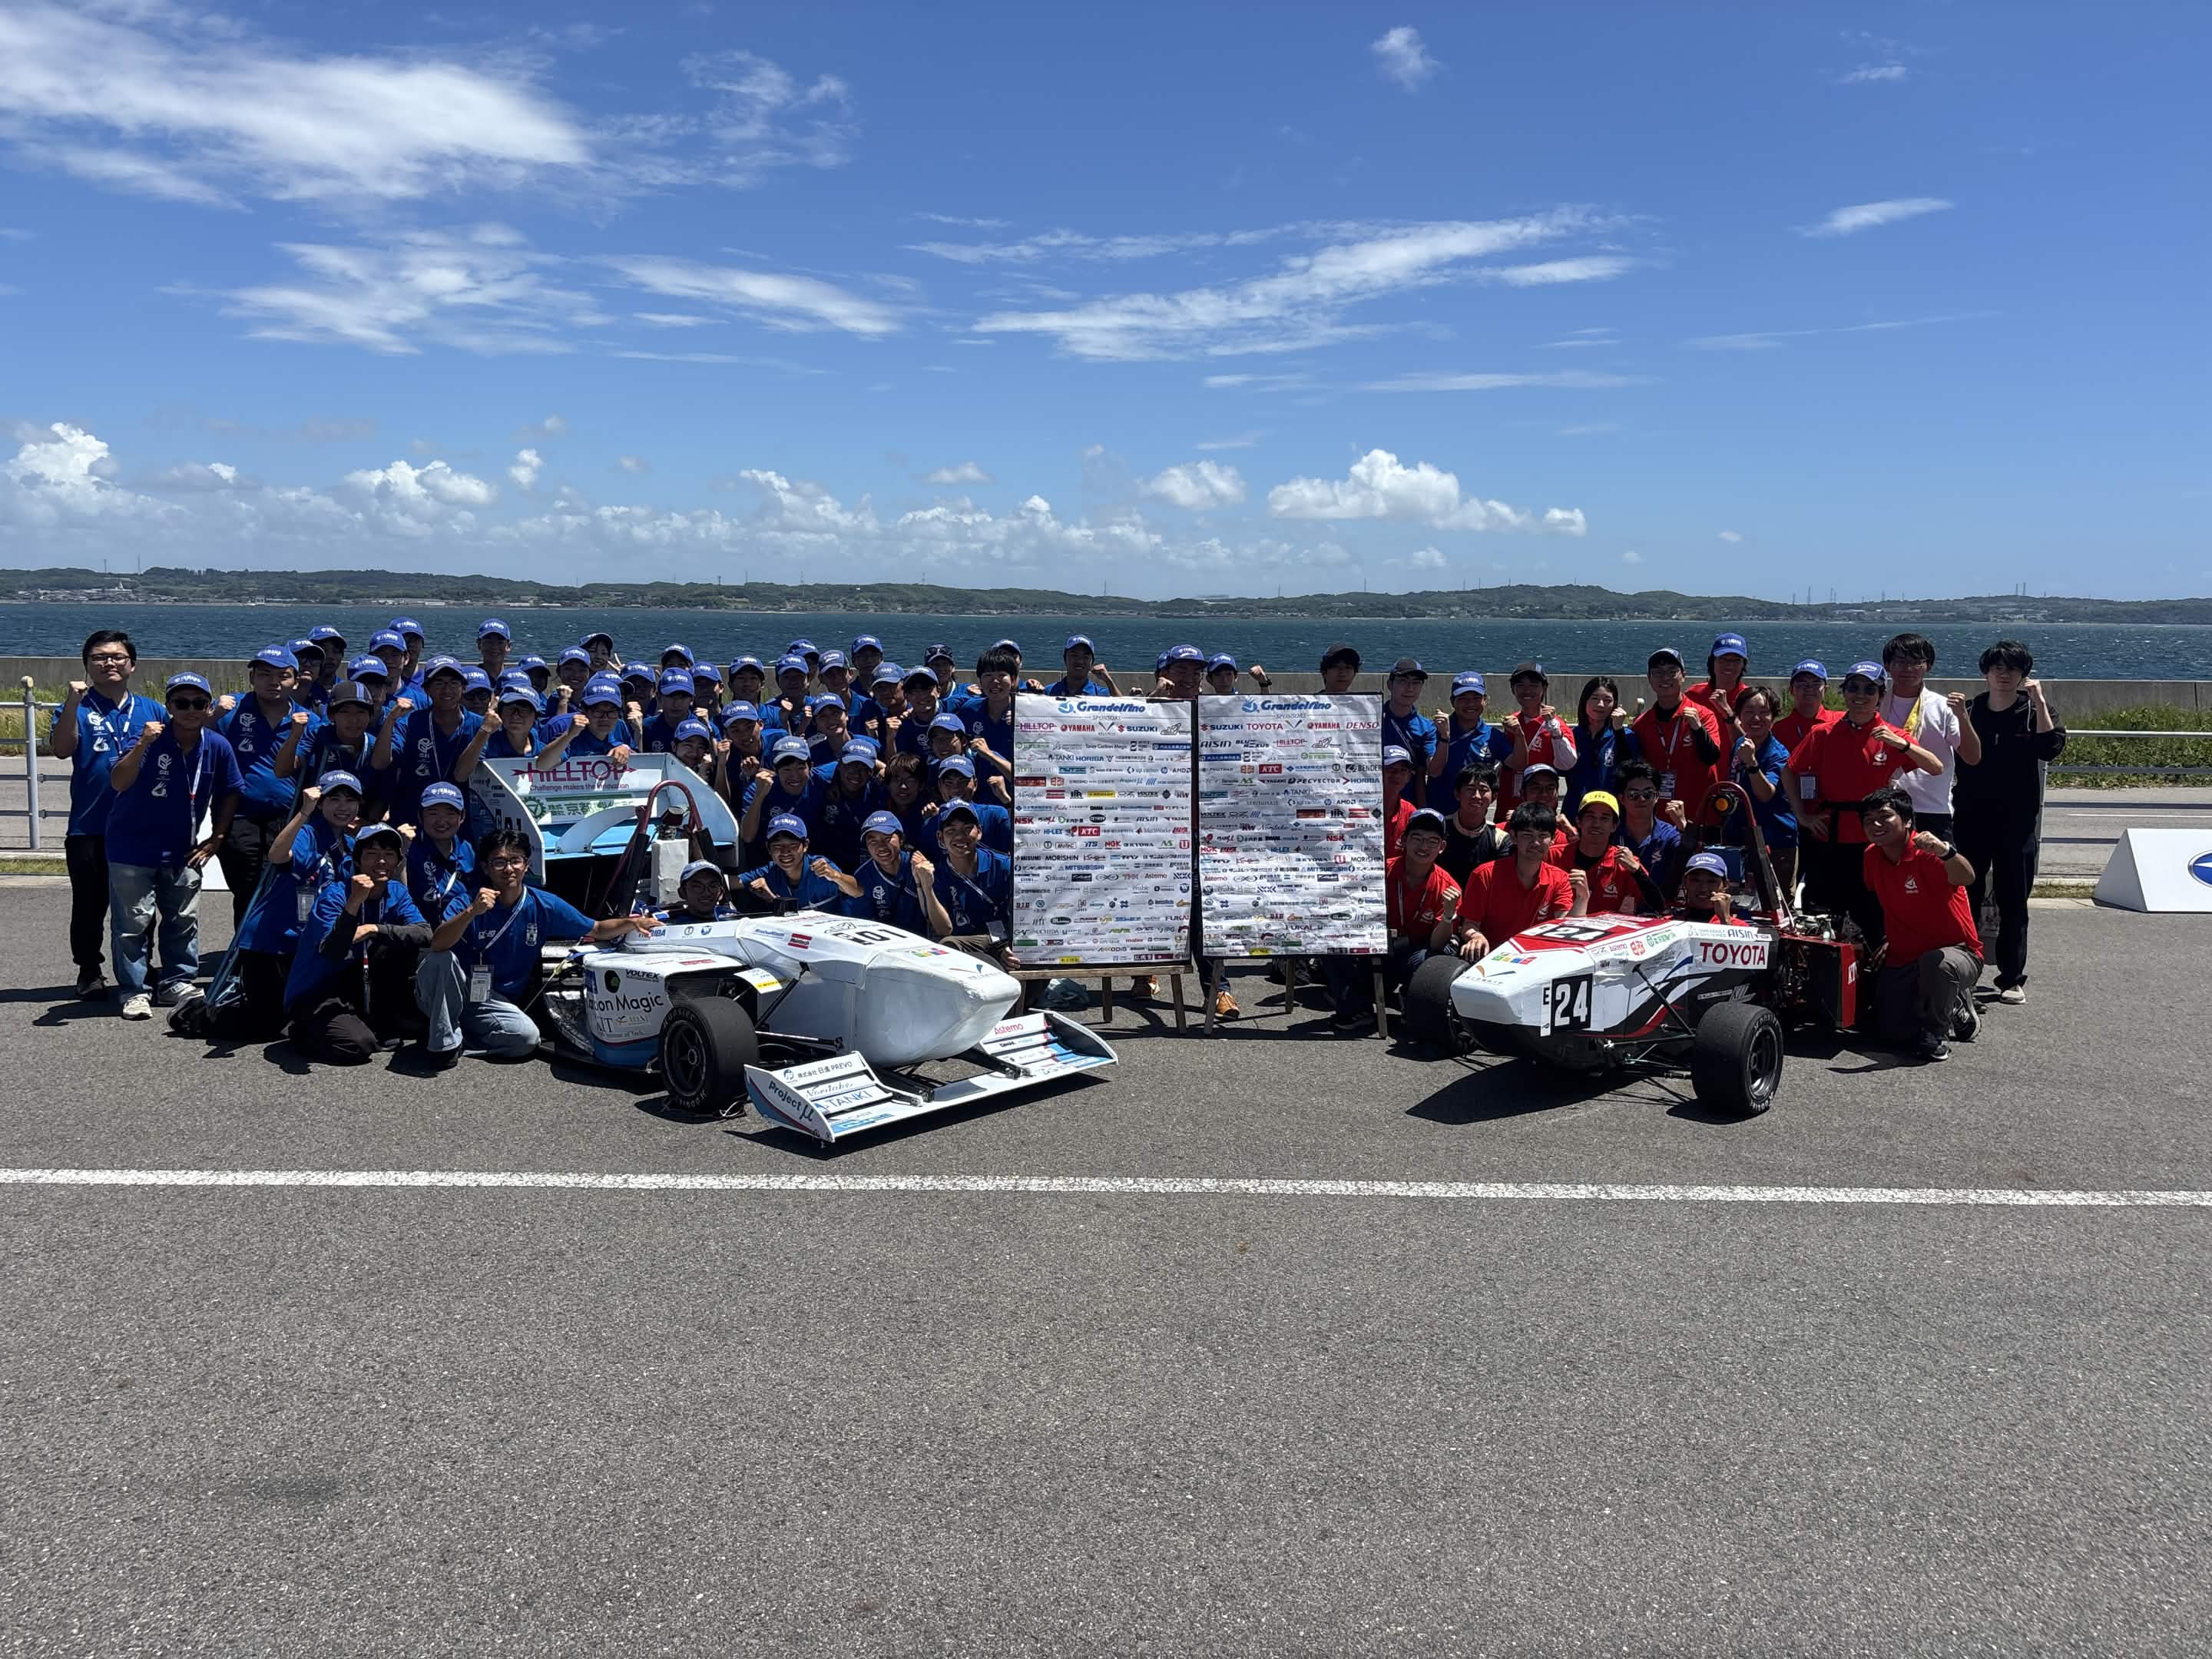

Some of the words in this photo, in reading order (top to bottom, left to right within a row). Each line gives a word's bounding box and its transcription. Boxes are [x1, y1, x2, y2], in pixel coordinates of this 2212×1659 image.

[1077, 701, 1146, 713] Grandelfino
[1261, 700, 1332, 710] Grandelfino
[530, 783, 562, 792] Challenge
[1727, 929, 1754, 939] AISIN
[1700, 942, 1766, 965] TOYOTA
[626, 969, 660, 979] VOLTEX
[615, 992, 664, 1013] Magic
[1543, 987, 1551, 1005] E
[1554, 980, 1589, 1027] 24
[995, 1023, 1024, 1036] Astemo
[768, 1081, 802, 1111] Project
[825, 1089, 873, 1108] TANKI
